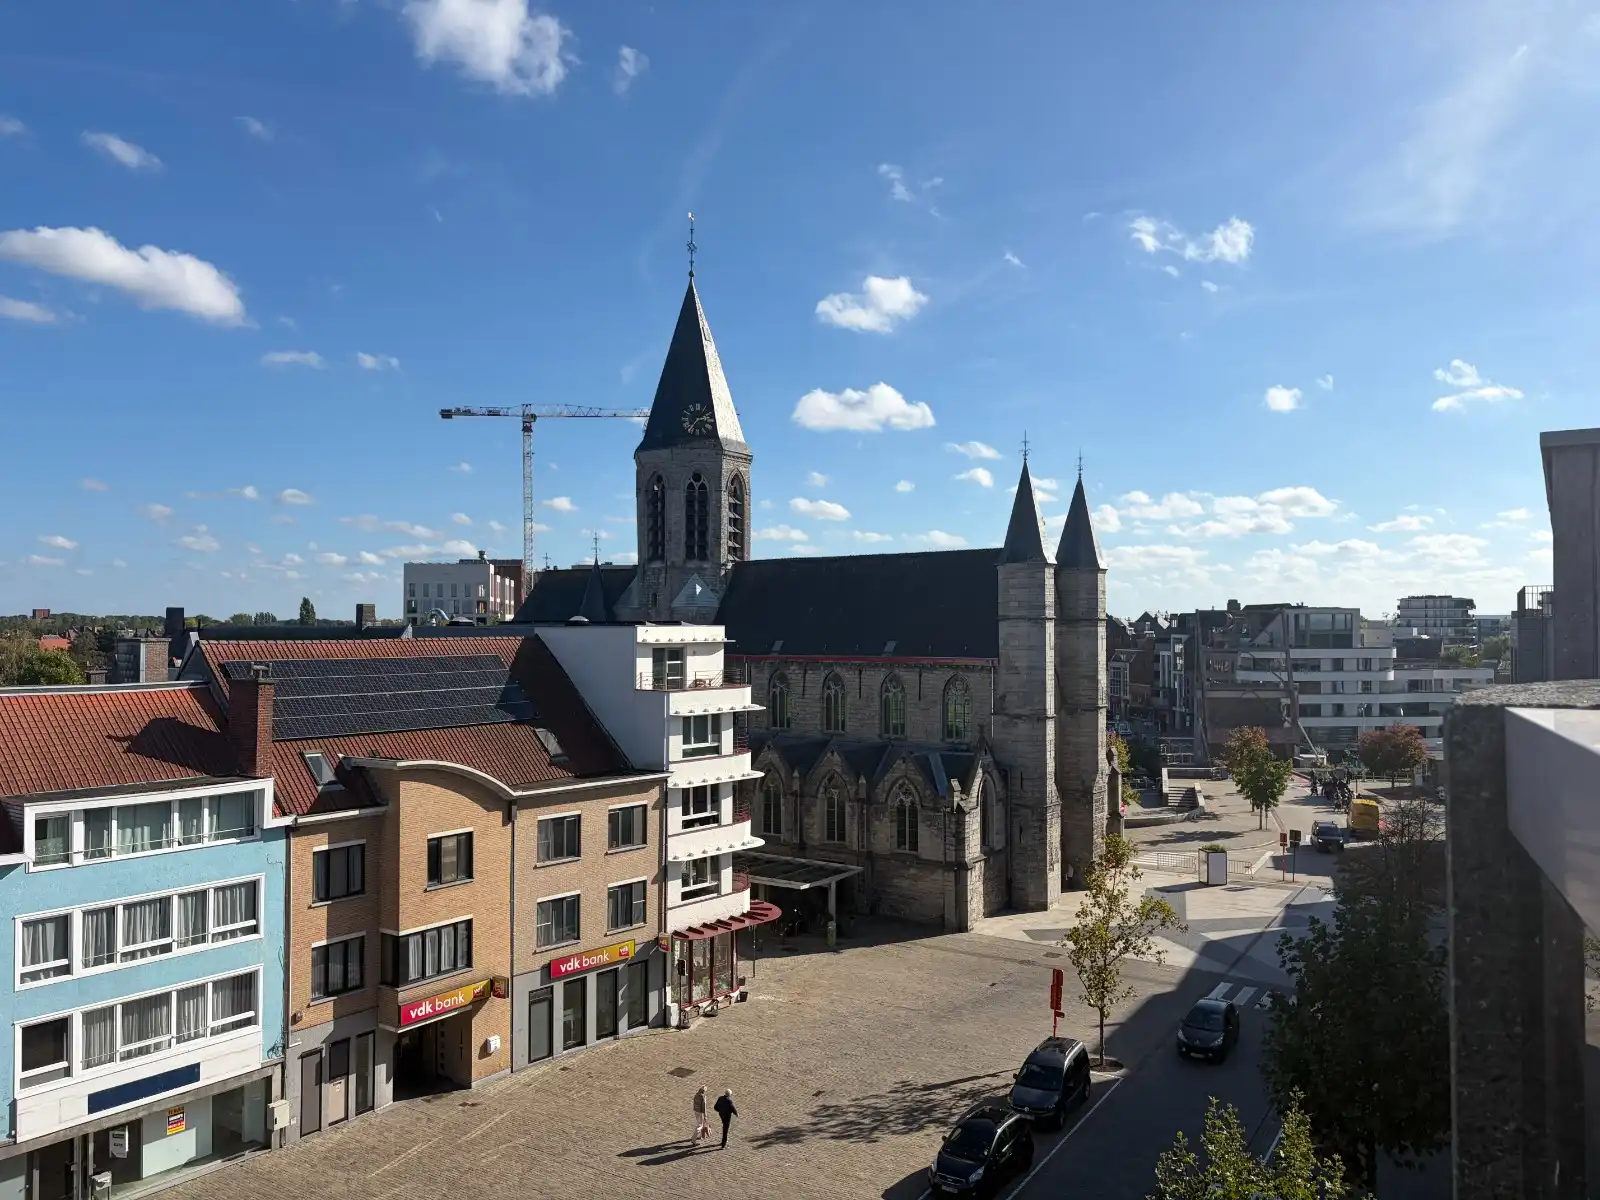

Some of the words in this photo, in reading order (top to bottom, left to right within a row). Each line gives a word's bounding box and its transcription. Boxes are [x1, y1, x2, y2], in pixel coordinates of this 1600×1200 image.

[560, 957, 581, 973] vdk
[582, 950, 609, 966] bank
[410, 1001, 433, 1018] vdk
[435, 991, 464, 1011] bank
